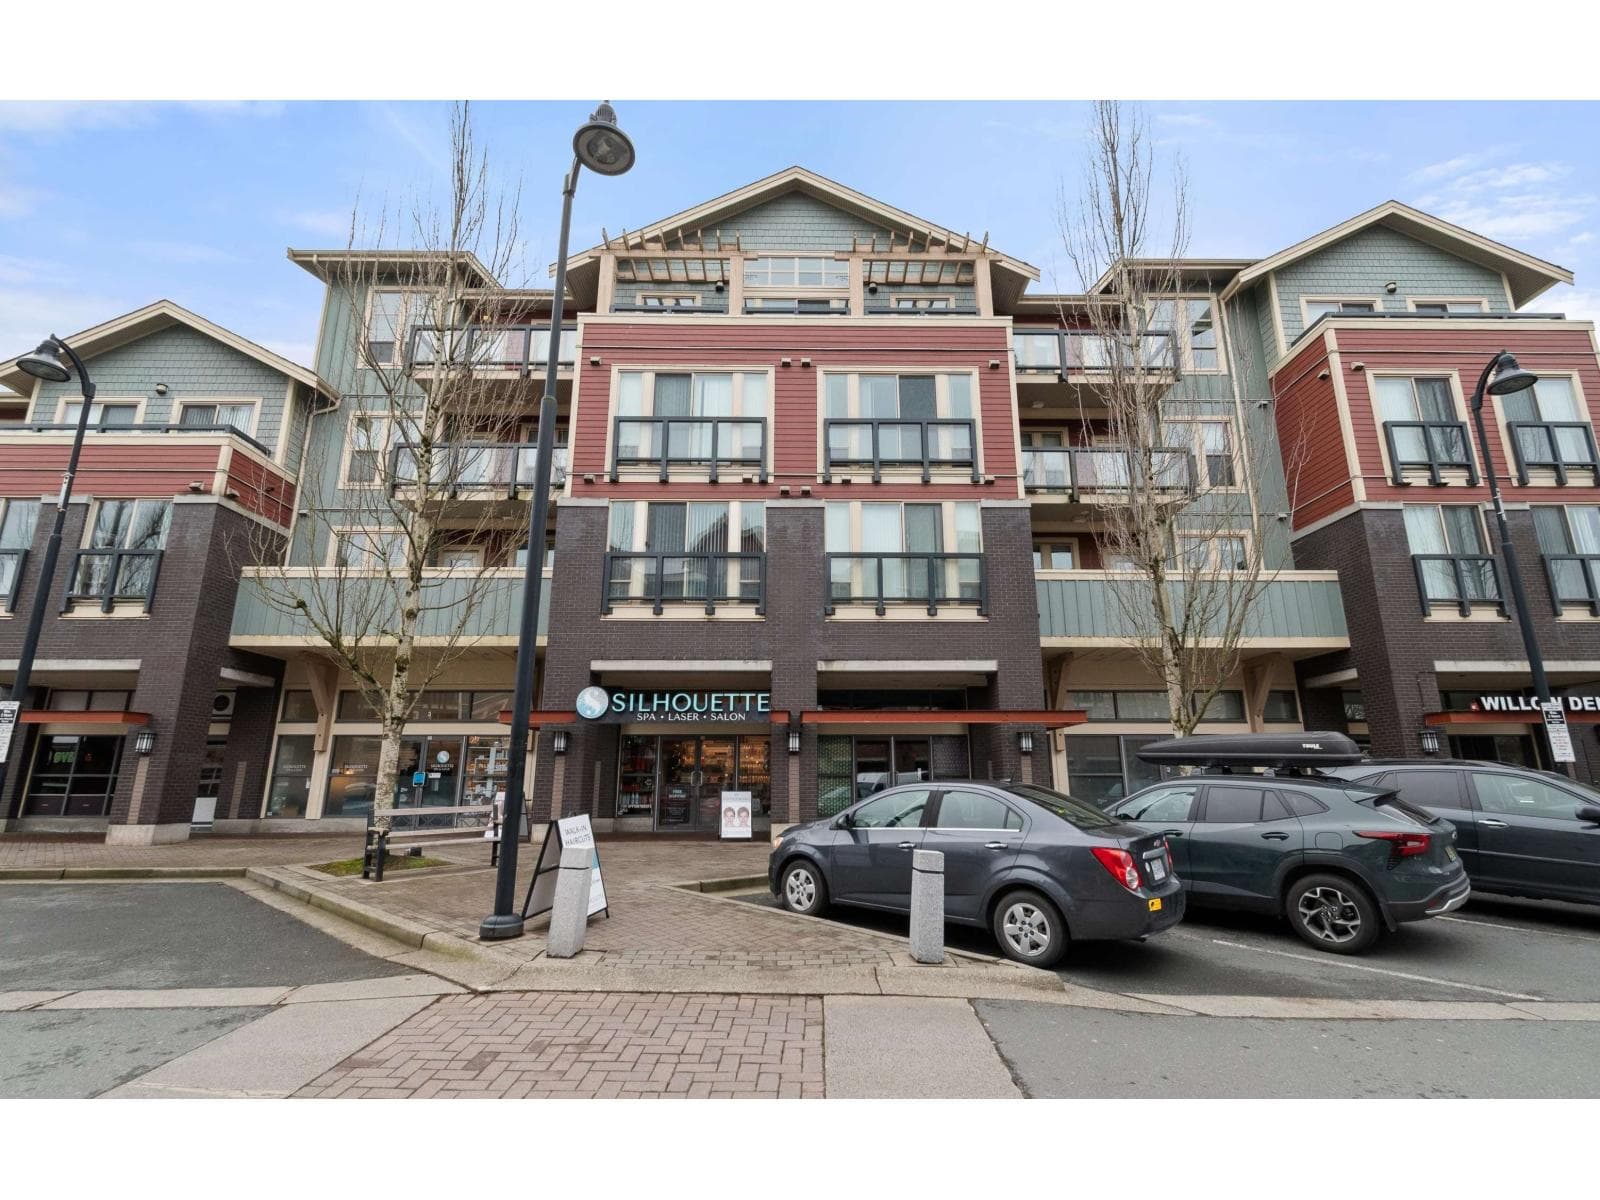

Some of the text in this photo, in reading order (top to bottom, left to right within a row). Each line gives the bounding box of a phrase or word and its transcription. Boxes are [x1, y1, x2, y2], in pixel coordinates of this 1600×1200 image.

[611, 693, 770, 712] SILHOUETTE
[636, 713, 746, 721] SPA LASER SALON
